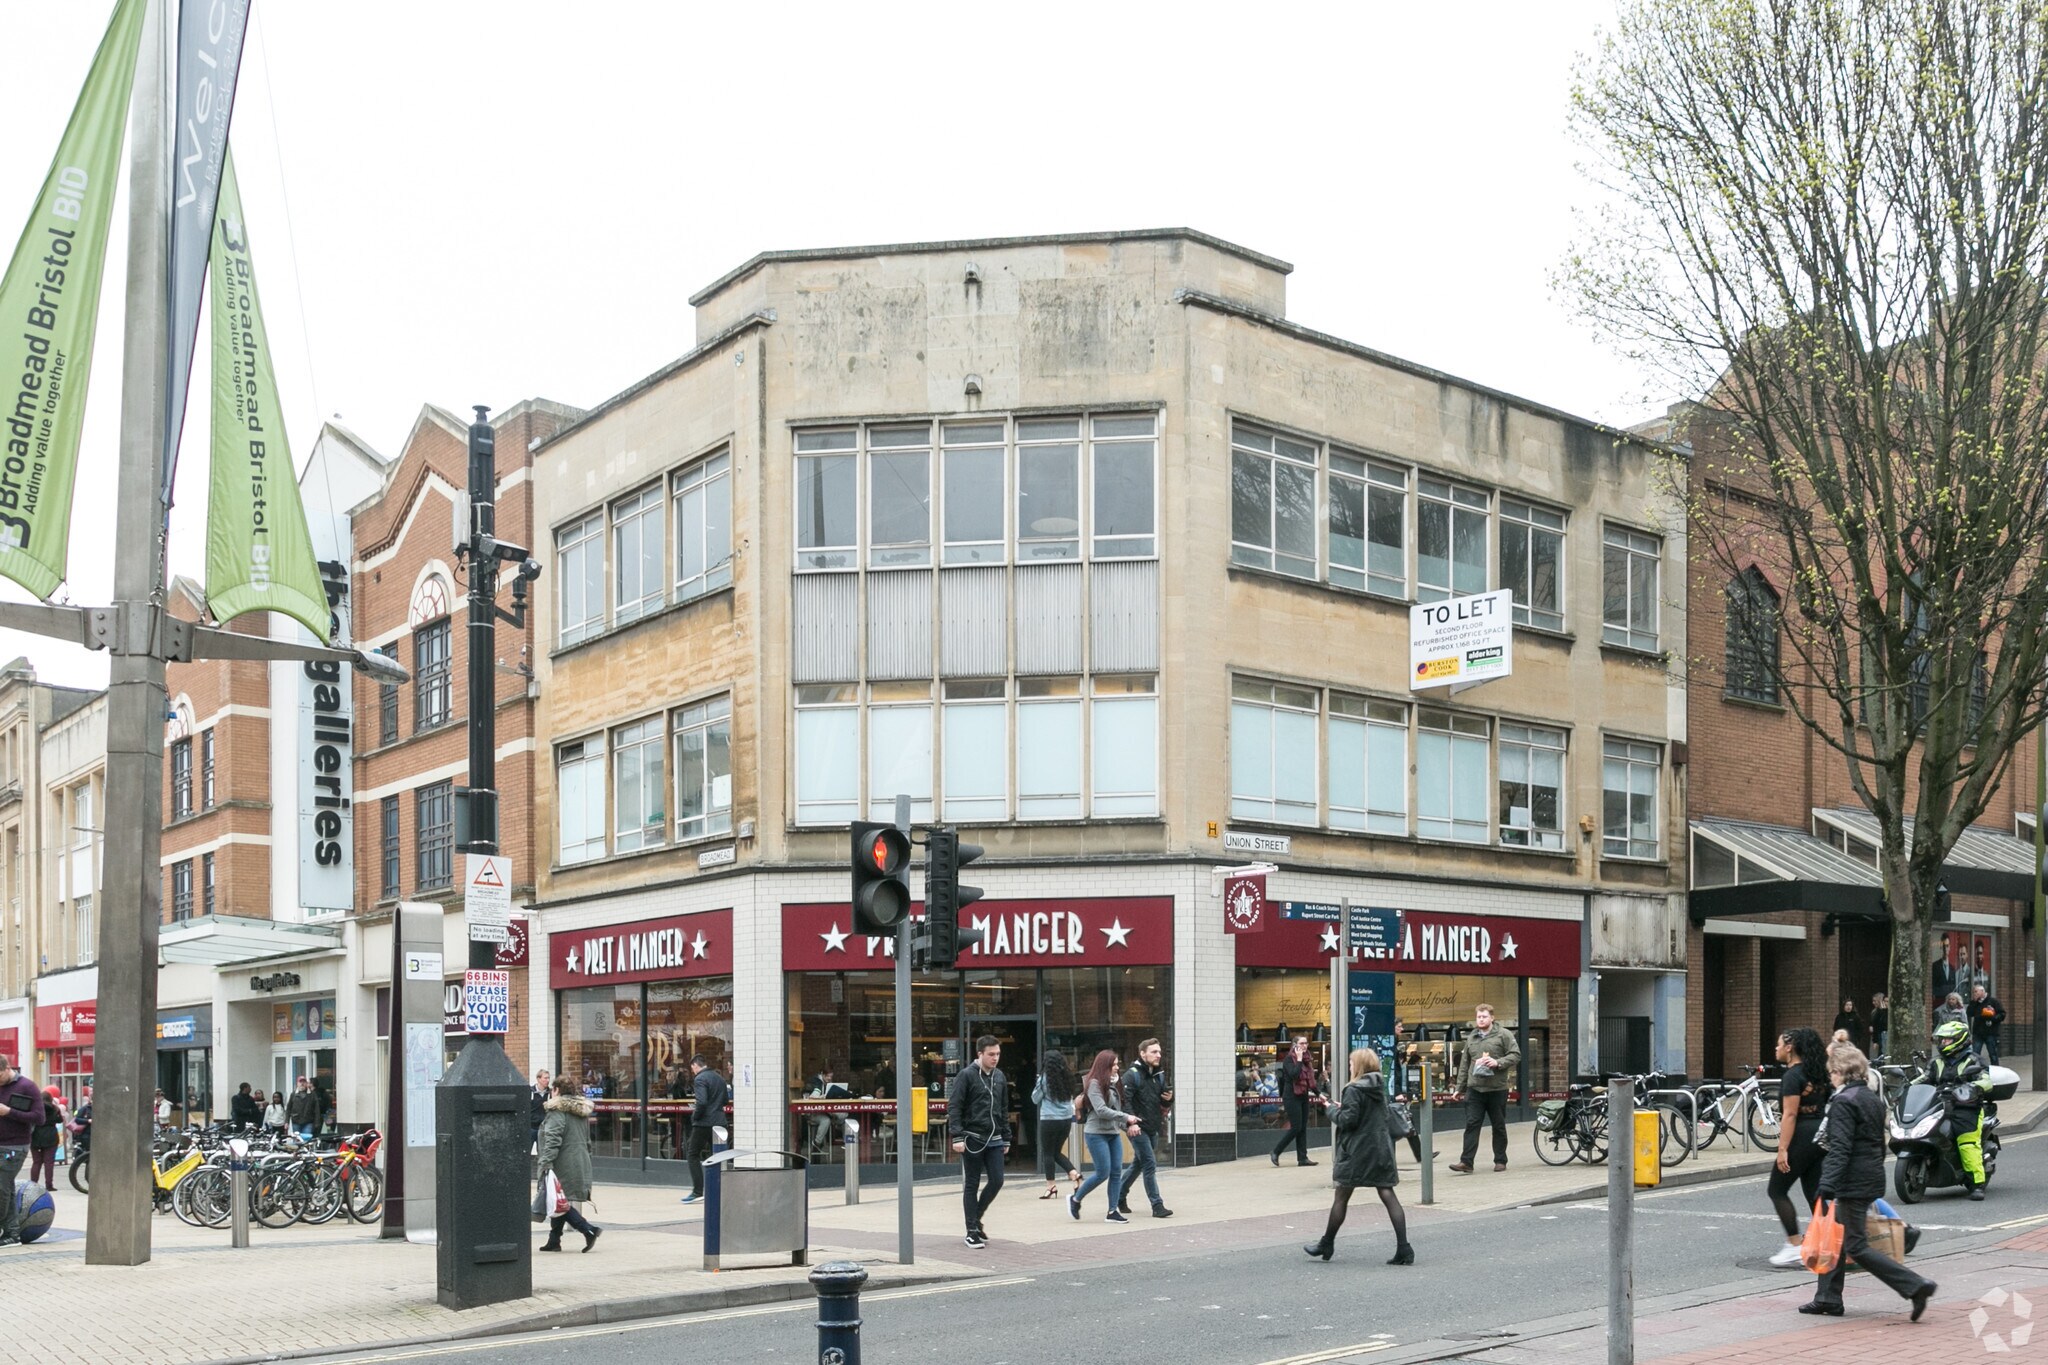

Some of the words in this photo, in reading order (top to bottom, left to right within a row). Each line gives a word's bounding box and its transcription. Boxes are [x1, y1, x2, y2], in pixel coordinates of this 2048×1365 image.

[225, 256, 236, 310] Adding
[0, 334, 51, 510] Broadmead
[27, 227, 76, 331] Bristol
[52, 166, 89, 221] BID
[230, 314, 240, 355] value
[235, 257, 264, 432] Broadmead
[43, 349, 67, 414] together
[233, 360, 245, 424] together
[36, 418, 53, 458] value
[22, 463, 47, 515] Adding
[250, 440, 269, 536] Bristol
[250, 544, 270, 592] BID
[1423, 606, 1450, 625] TO
[1458, 597, 1497, 620] LET
[1414, 635, 1459, 647] REFURBISHED
[1460, 631, 1482, 640] OFFICE
[1484, 626, 1506, 635] SPACE
[1435, 625, 1460, 635] SECOND
[1462, 622, 1484, 630] FLOOR
[1428, 645, 1453, 653] APPROX
[304, 660, 350, 867] galleries
[1225, 835, 1251, 848] UNION
[1255, 837, 1285, 850] STREET
[1246, 880, 1261, 901] COFFEE
[484, 927, 505, 935] loading
[972, 911, 1085, 955] MANGER
[1249, 909, 1260, 926] FOOD
[584, 935, 614, 976] PRET
[617, 934, 627, 973] A
[630, 927, 685, 971] MANGER
[1402, 923, 1415, 959] A
[1421, 924, 1491, 963] MANGER
[467, 972, 481, 980] 66
[482, 972, 507, 981] BINS
[467, 986, 507, 995] PLEASE
[467, 1003, 507, 1014] YOUR
[1277, 998, 1312, 1015] Freshly
[1426, 990, 1459, 1009] food
[467, 1014, 508, 1031] GUM
